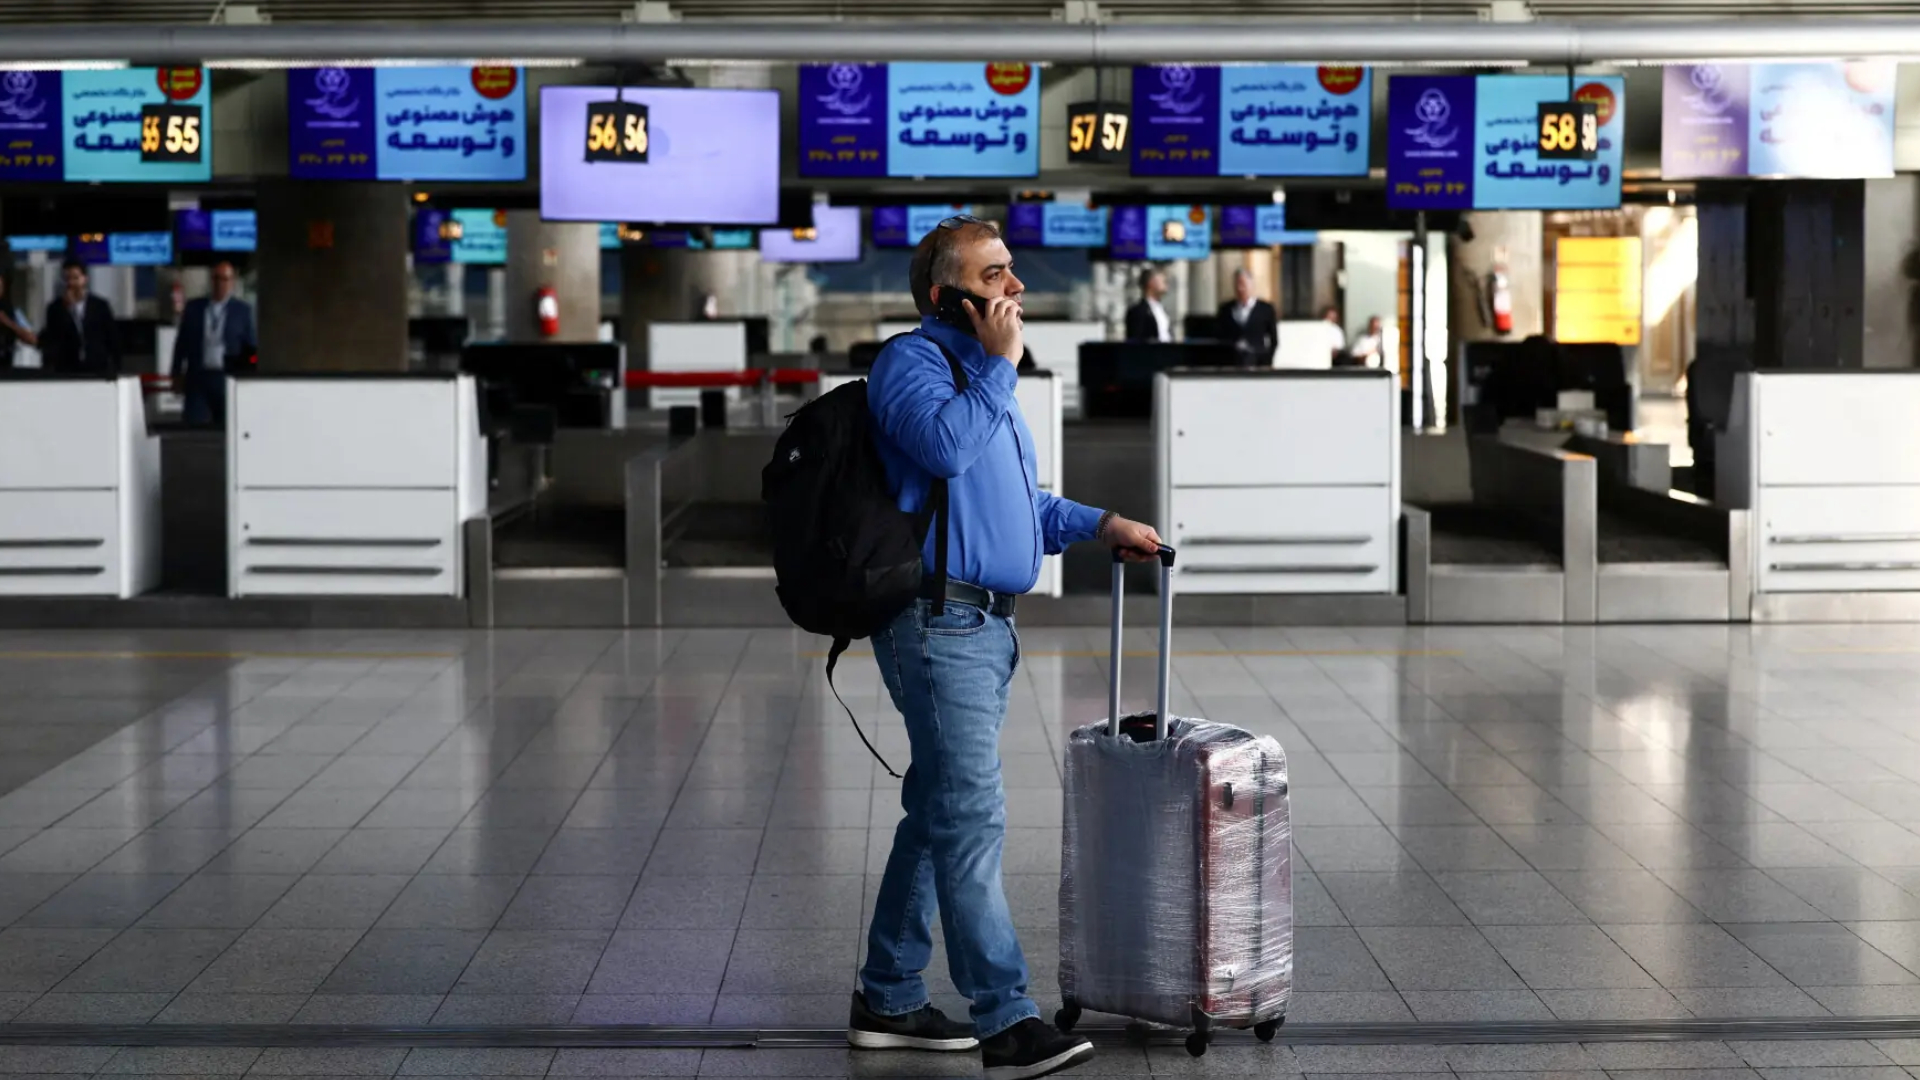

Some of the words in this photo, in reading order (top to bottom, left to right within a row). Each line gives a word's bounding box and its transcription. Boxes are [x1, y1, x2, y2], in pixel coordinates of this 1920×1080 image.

[386, 106, 459, 127] مصنوعی
[462, 104, 515, 125] هوش
[899, 103, 972, 123] مصنوعی
[975, 100, 1028, 122] هوش
[1230, 101, 1304, 122] مصنوعی
[1306, 99, 1359, 121] هوش
[165, 115, 200, 153] 55
[386, 129, 497, 157] توسعه
[588, 114, 617, 151] 56
[624, 114, 648, 153] 56
[899, 125, 1009, 154] توسعه
[1013, 132, 1028, 154] و
[1069, 114, 1097, 152] 57
[1101, 113, 1128, 151] 57
[1230, 124, 1340, 153] توسعه
[1344, 131, 1359, 153] و
[1540, 113, 1577, 151] 58
[1581, 113, 1598, 151] 58
[501, 135, 515, 158] و
[1596, 163, 1611, 186] و
